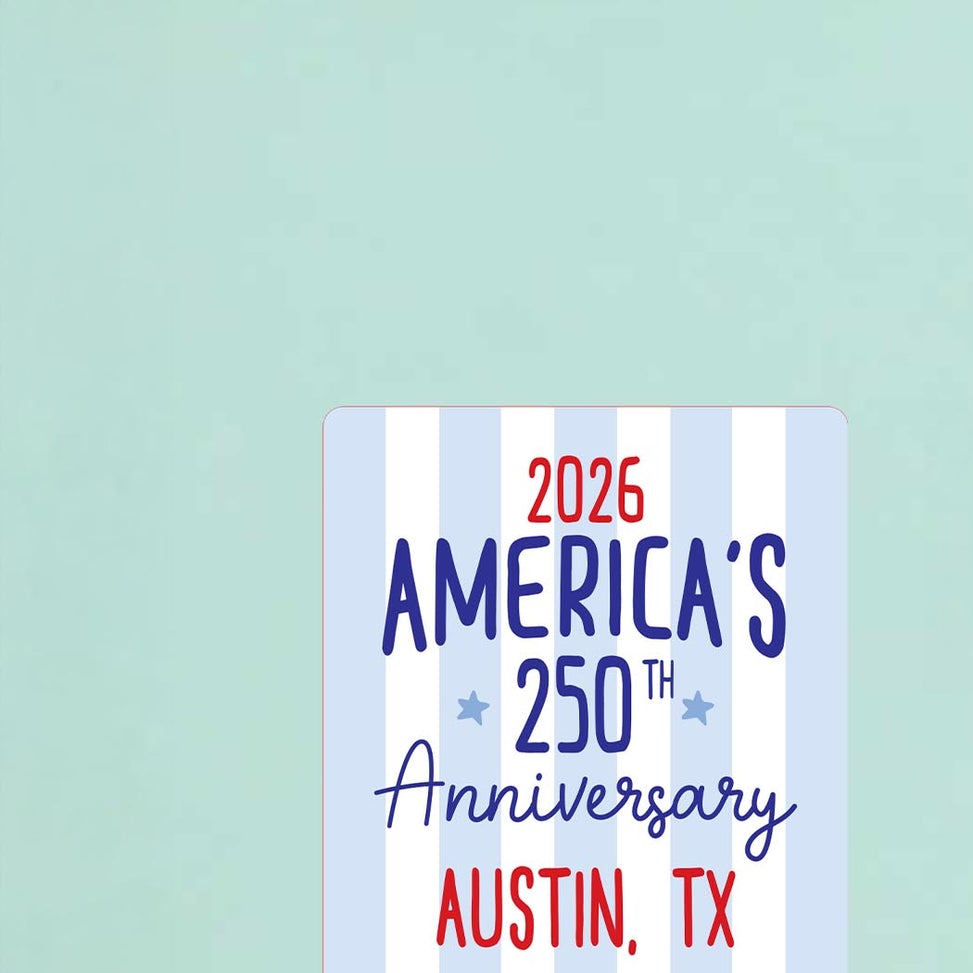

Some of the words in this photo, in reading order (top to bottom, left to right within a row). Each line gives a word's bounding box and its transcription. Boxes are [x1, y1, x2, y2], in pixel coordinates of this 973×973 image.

[527, 455, 645, 524] 2026
[381, 533, 787, 658] AMERICA'S
[374, 738, 798, 862] Anniversary
[436, 865, 637, 957] AUSTIN,
[671, 866, 737, 948] TX
